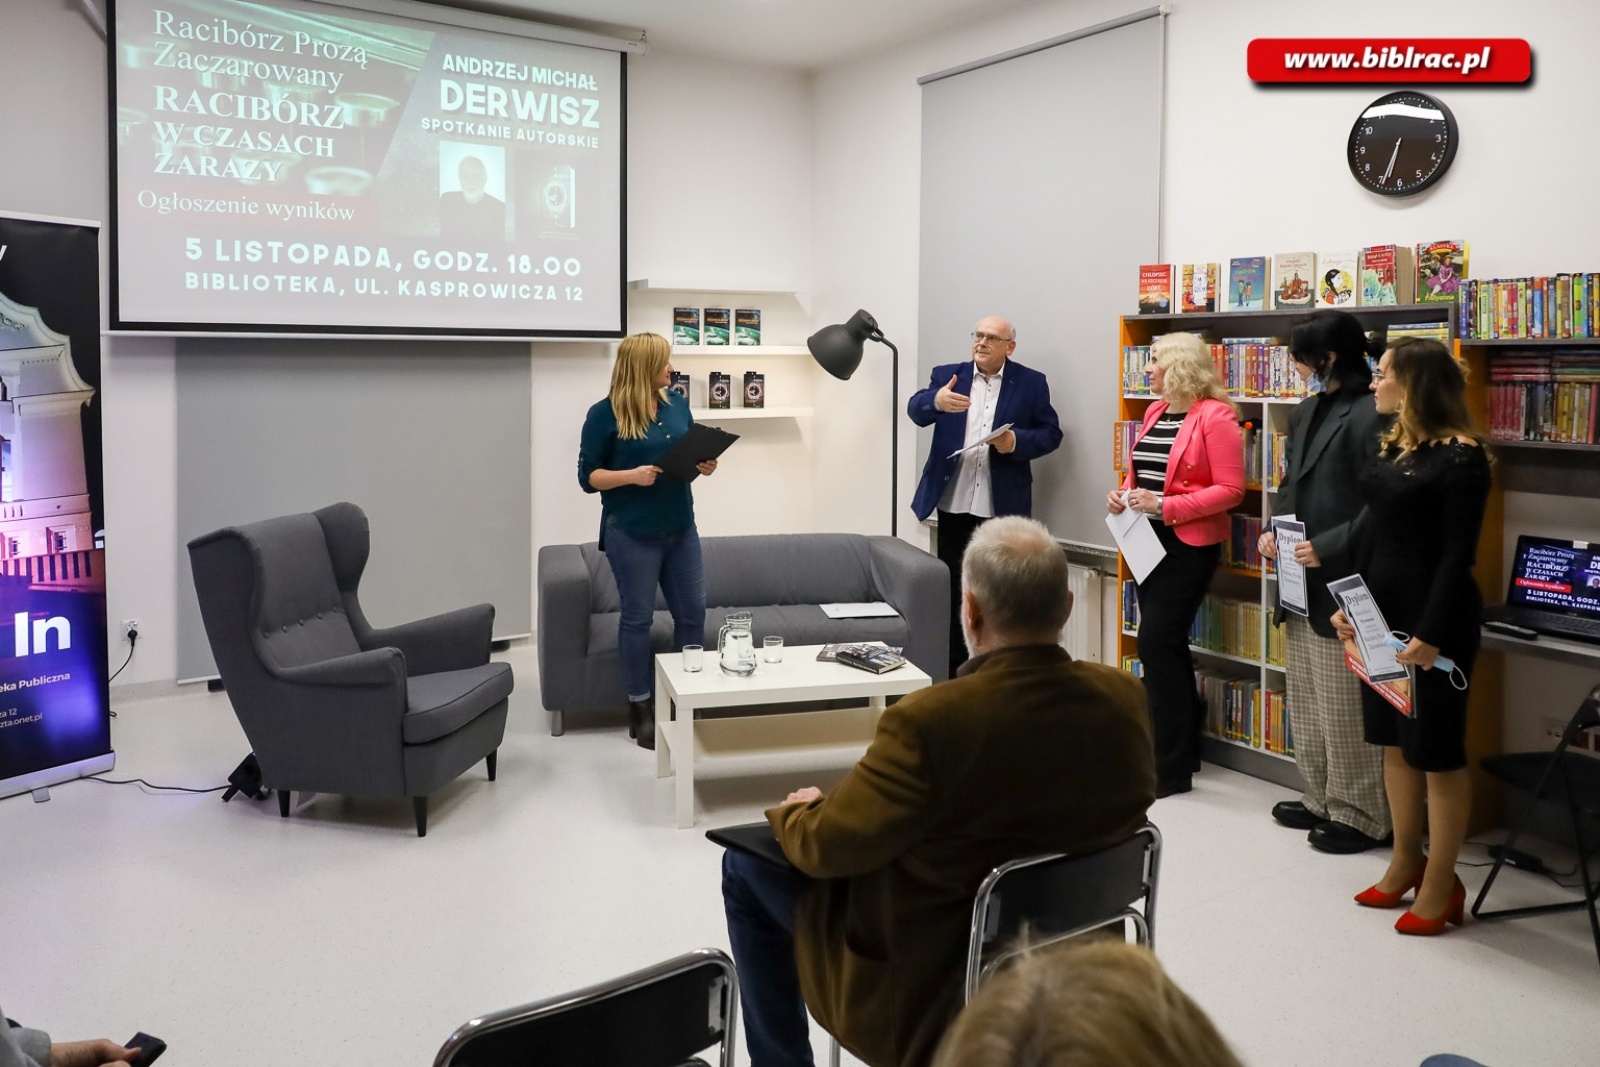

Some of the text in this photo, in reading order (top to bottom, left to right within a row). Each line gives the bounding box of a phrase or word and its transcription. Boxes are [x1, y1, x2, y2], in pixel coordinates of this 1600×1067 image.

[152, 9, 369, 70] Racibórz Prozą
[153, 41, 344, 94] Zaczarowany
[443, 53, 599, 91] ANDRZEJ MICHAŁ
[153, 85, 345, 130] RACIBÓRZ
[440, 78, 600, 129] DERWISZ
[154, 121, 335, 158] W CZASACH
[421, 117, 600, 149] SPOTKANIE AUTORSKIE
[1365, 126, 1373, 135] 10
[1435, 134, 1442, 143] 3
[1360, 146, 1366, 155] 9
[1365, 163, 1371, 172] 8
[1397, 179, 1403, 187] 6
[1416, 169, 1422, 178] 5
[137, 189, 356, 222] Ogłoszenie wyników
[185, 237, 581, 277] 5 LISTOPADA, GODZ. 18.00
[185, 272, 583, 301] BIBLIOTEKA, UL. KASPROWICZA 12
[14, 611, 71, 658] In
[18, 672, 71, 690] Publiczna
[8, 708, 18, 716] 12
